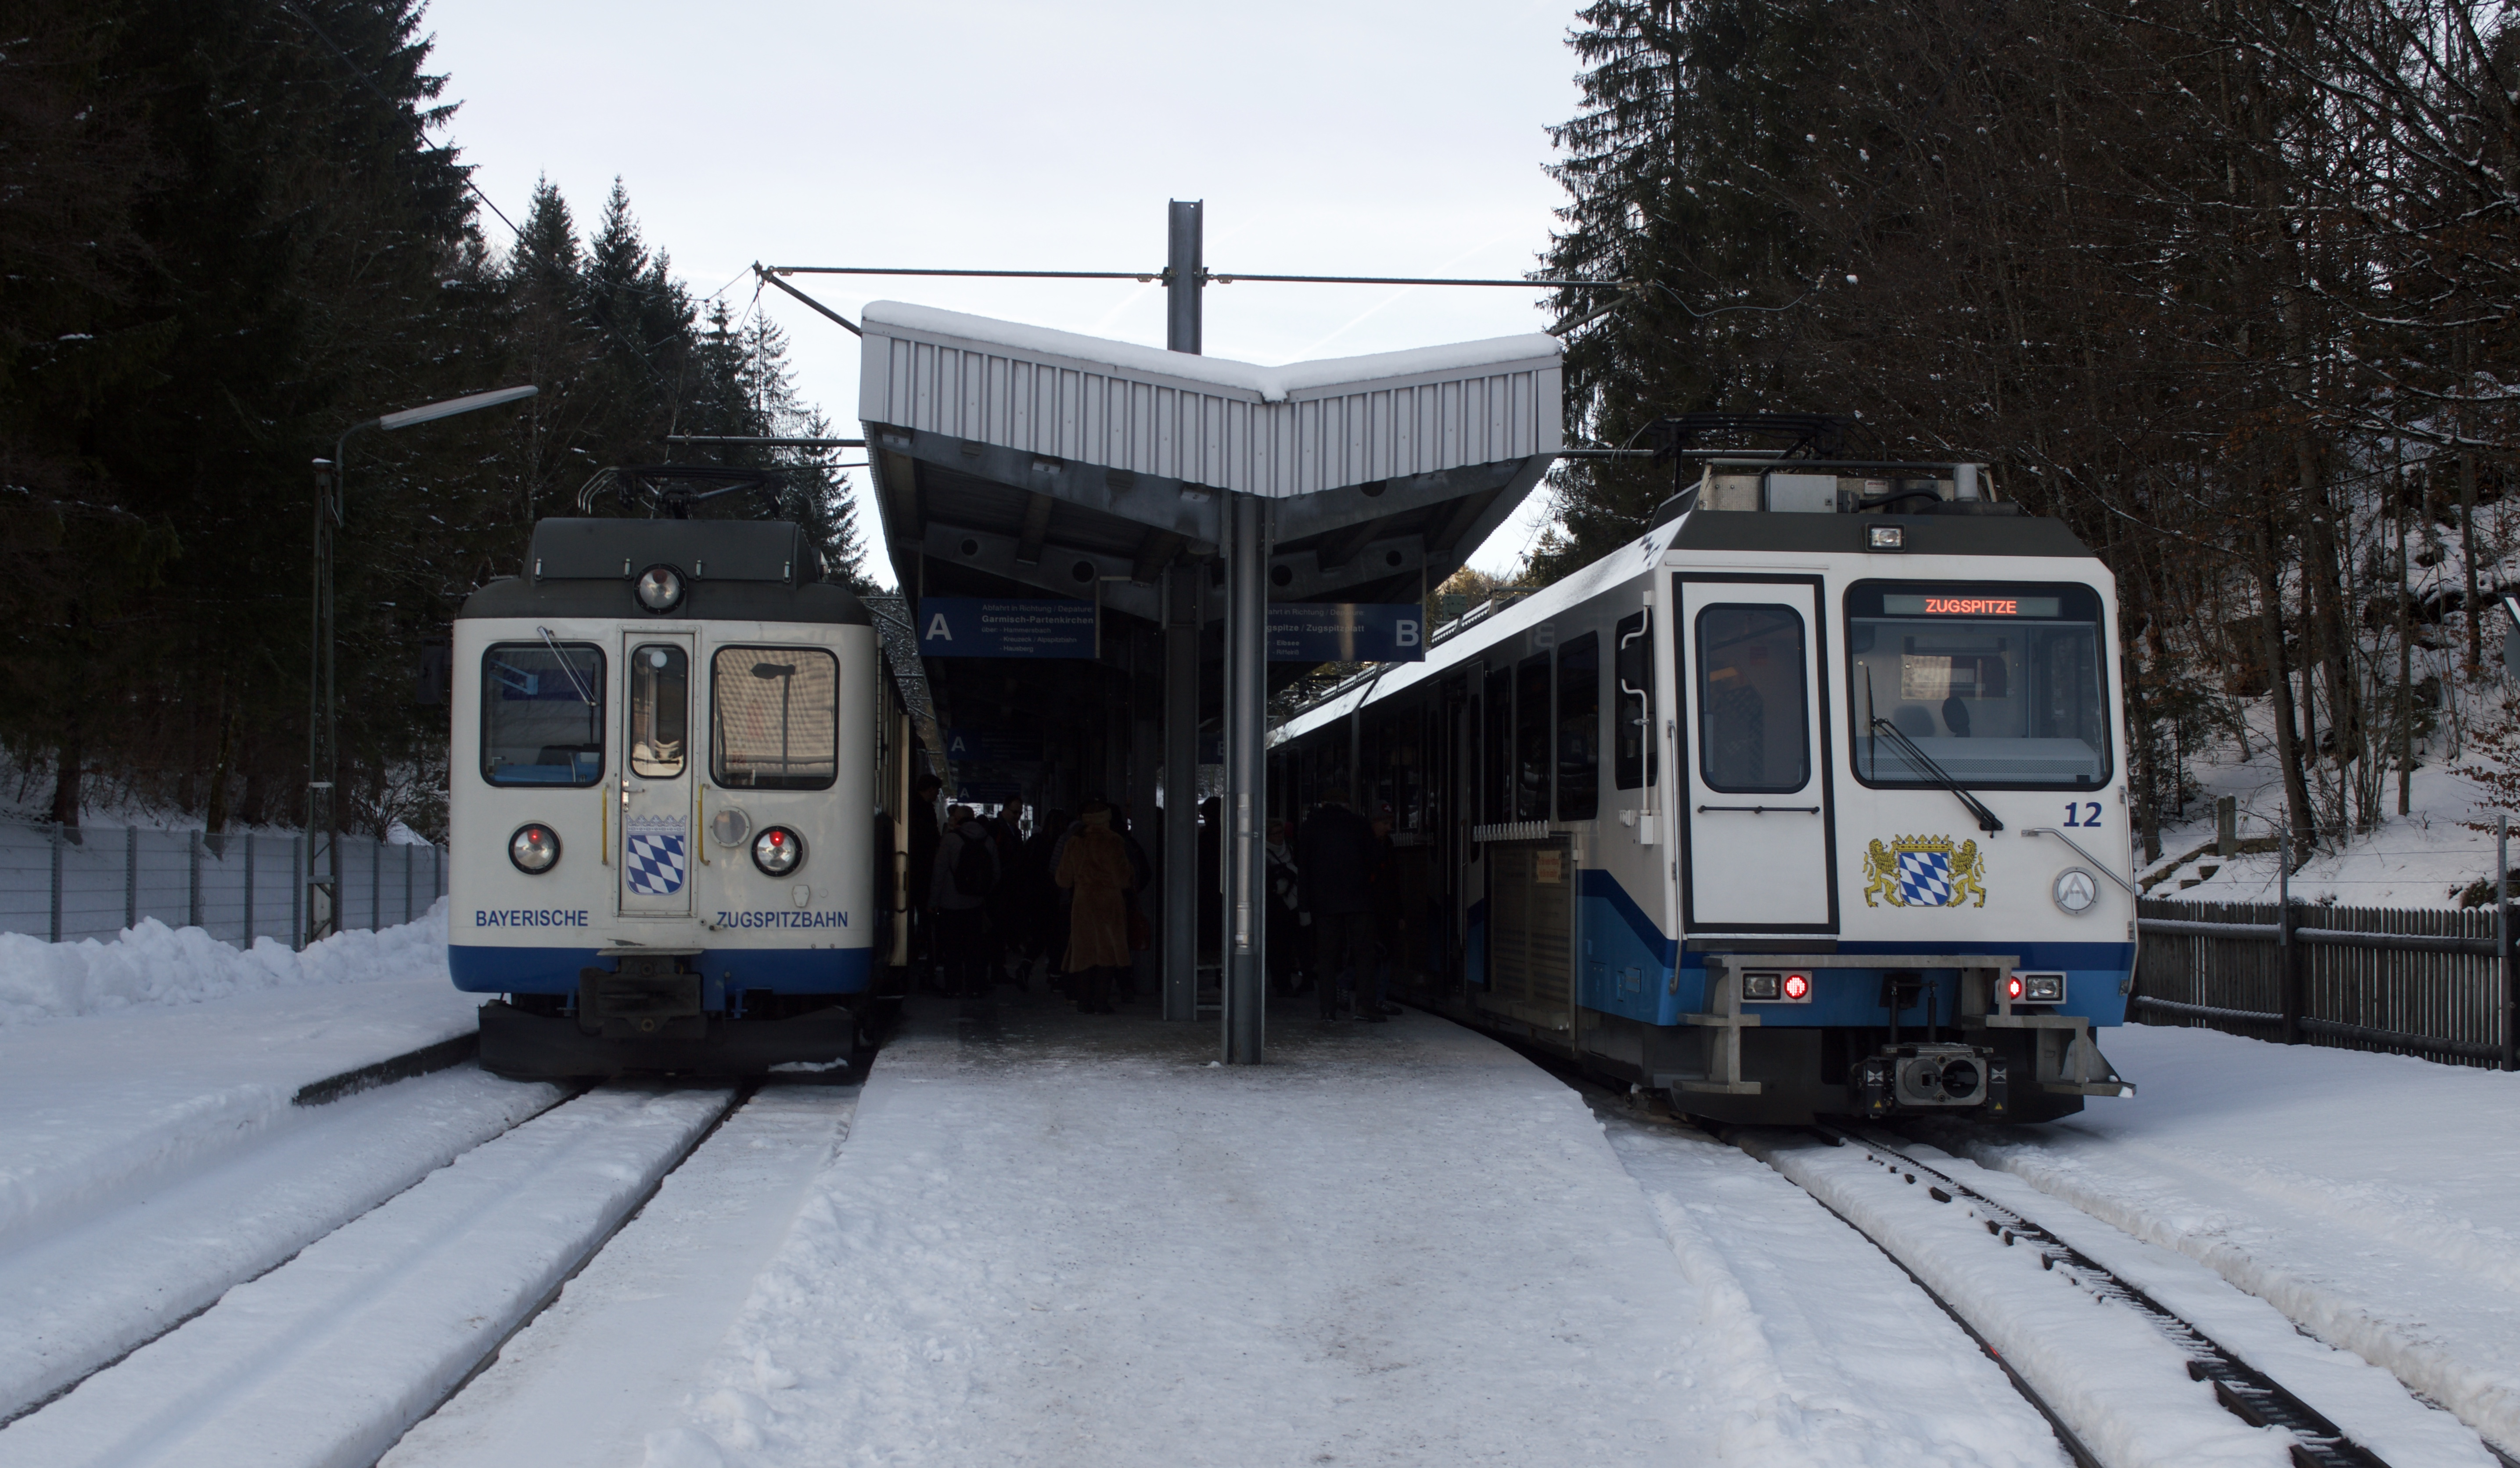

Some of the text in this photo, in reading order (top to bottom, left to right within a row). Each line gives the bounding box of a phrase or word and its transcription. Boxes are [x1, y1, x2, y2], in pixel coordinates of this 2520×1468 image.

[1926, 599, 2017, 614] ZUGSPITZE
[925, 613, 953, 641] A
[981, 615, 1094, 624] Garmisch-Partenkirchen
[1267, 624, 1299, 633] gspitze
[1306, 624, 1365, 633] Zugspitzplatt
[1396, 619, 1419, 647] B
[951, 736, 966, 752] A
[960, 787, 970, 798] A
[2063, 802, 2101, 827] 12
[2060, 873, 2091, 901] A
[476, 910, 848, 928] BAYERISCHE ZUGSPITZBAHN
